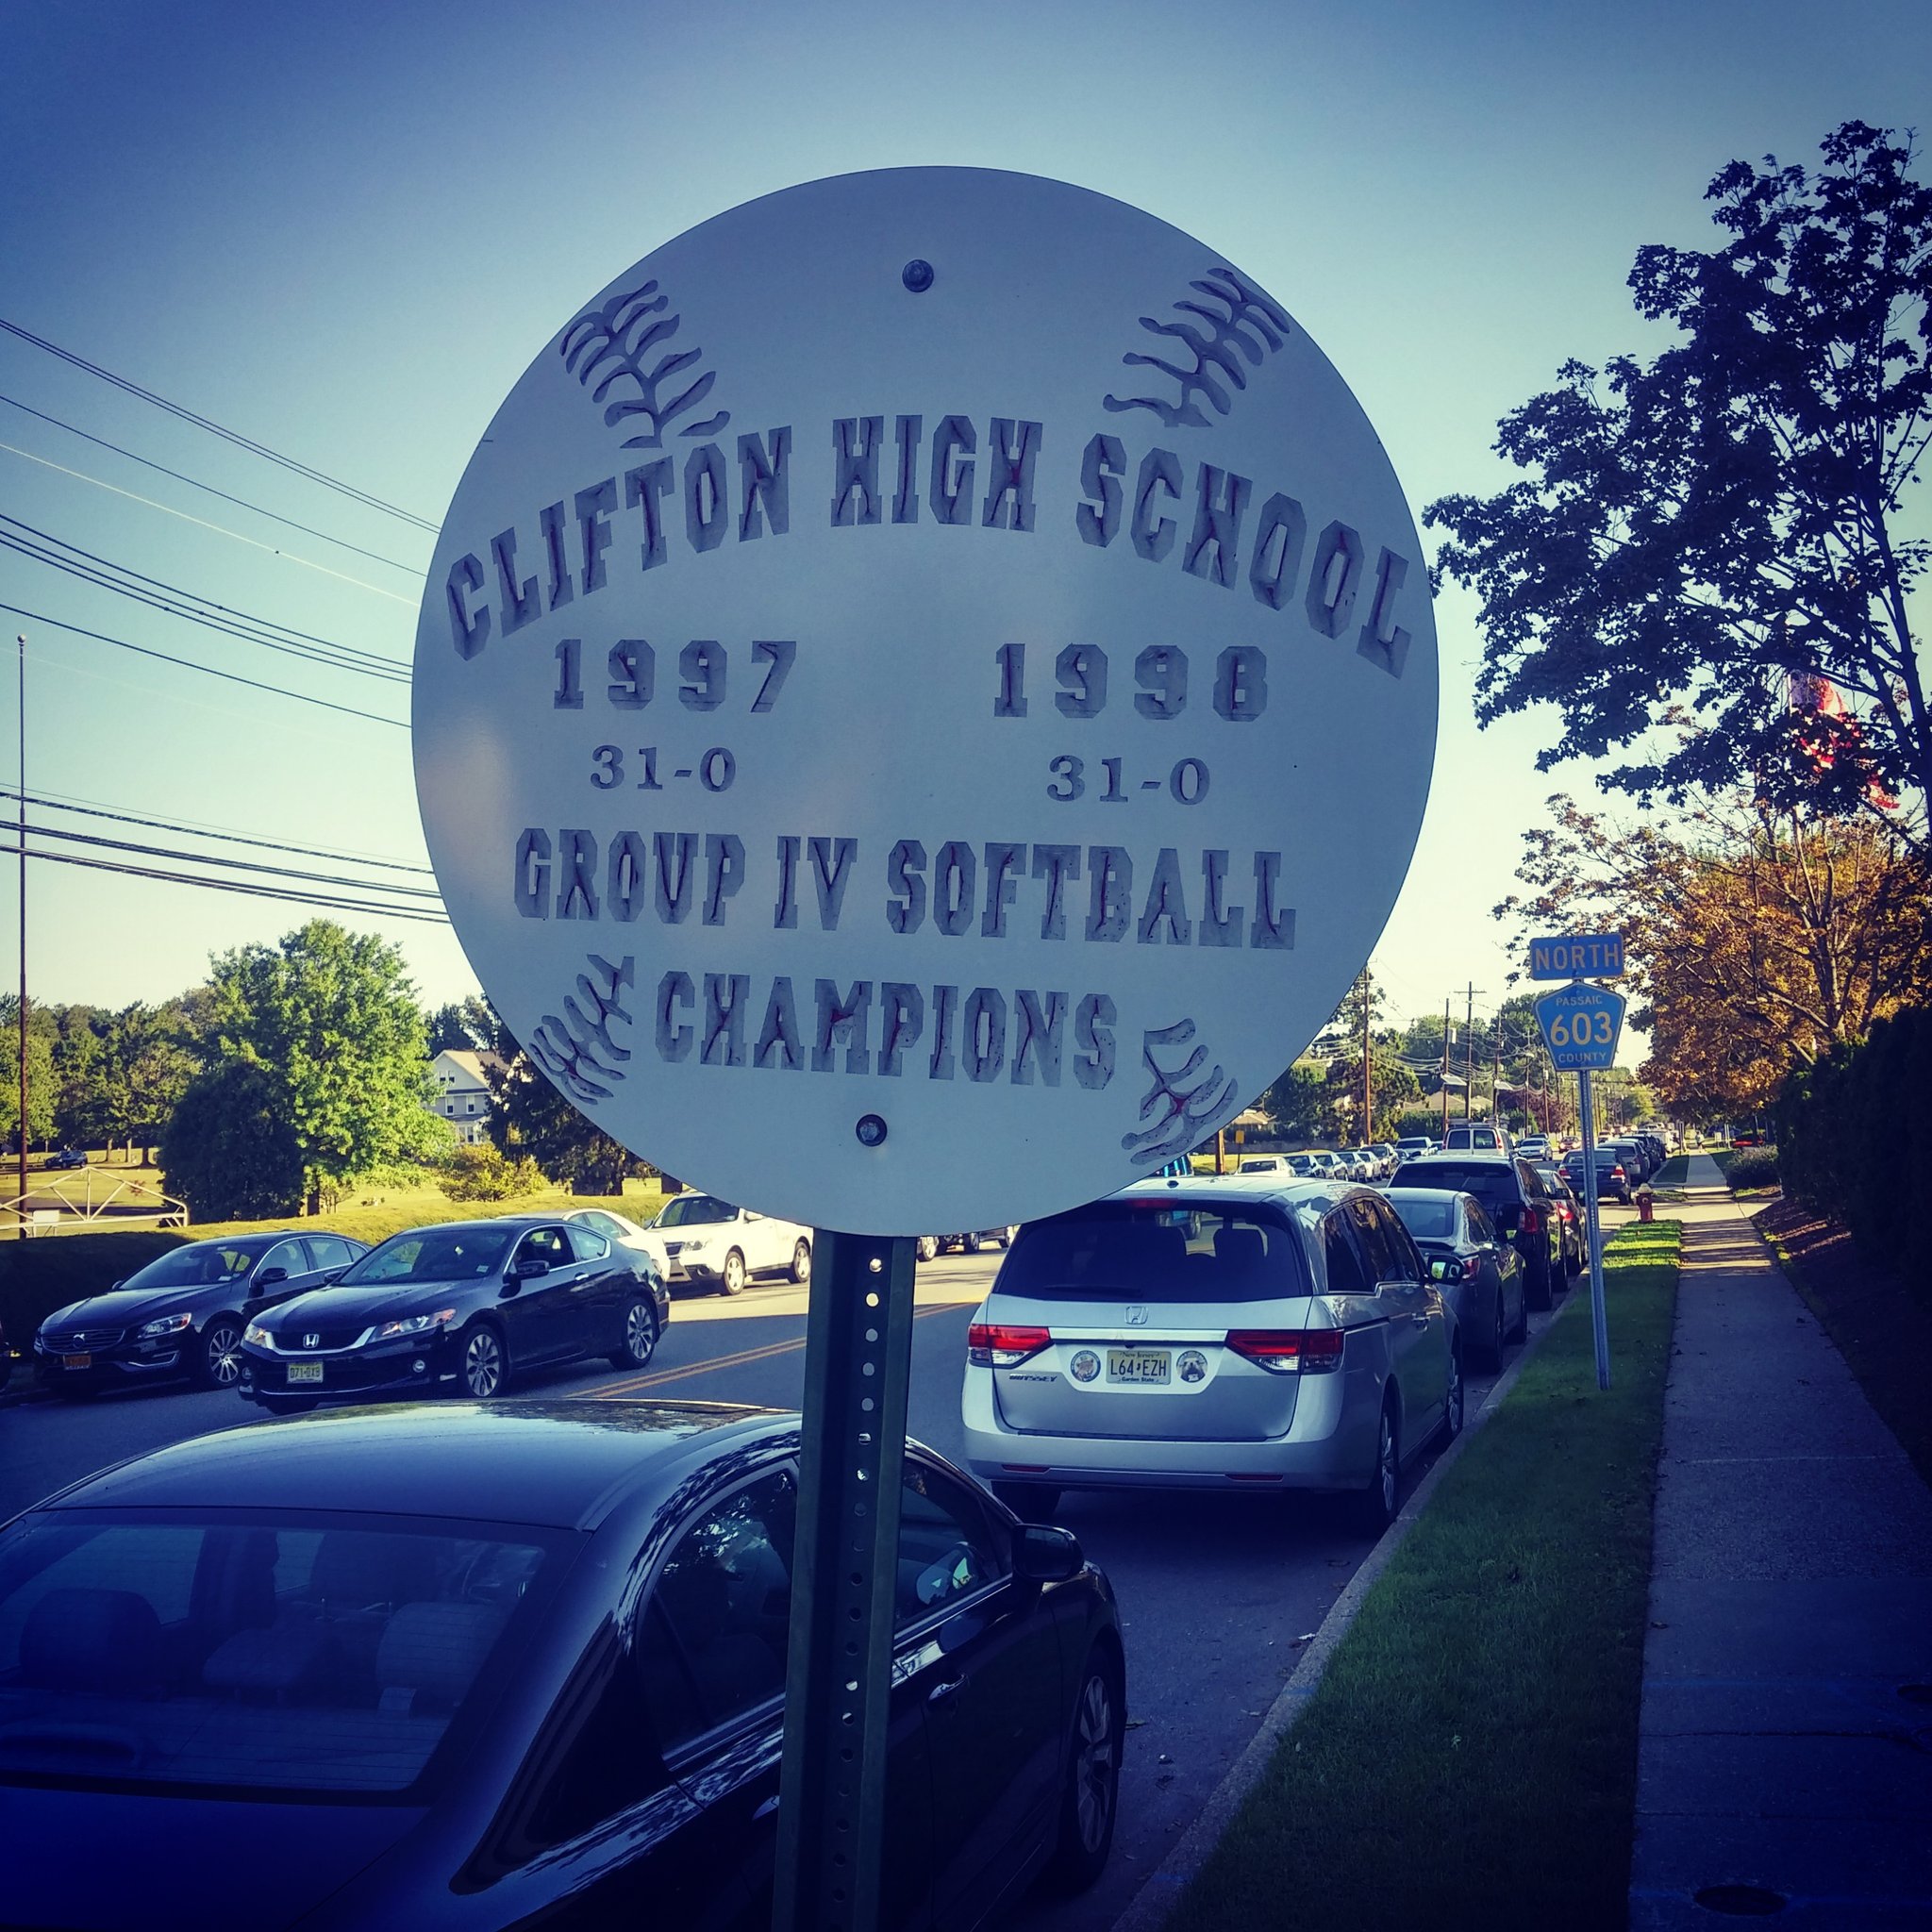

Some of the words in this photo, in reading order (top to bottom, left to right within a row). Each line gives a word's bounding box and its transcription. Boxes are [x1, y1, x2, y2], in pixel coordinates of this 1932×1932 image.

[446, 425, 792, 661] CLIFTON
[831, 414, 1042, 533] HIGH
[1075, 432, 1413, 680] SCHOOL
[554, 639, 796, 713] 1997
[993, 642, 1268, 722] 1998
[590, 744, 737, 792] 31-0
[1046, 755, 1210, 806] 31-0
[514, 827, 746, 926] GROUP
[774, 836, 858, 931] IV
[886, 839, 1297, 950] SOFTBALL
[1535, 942, 1620, 971] NORTH
[1556, 995, 1603, 1007] PASSAIC
[655, 970, 1118, 1091] CHAMPIONS
[1550, 1011, 1613, 1046] 603
[1557, 1052, 1607, 1063] COUNTY
